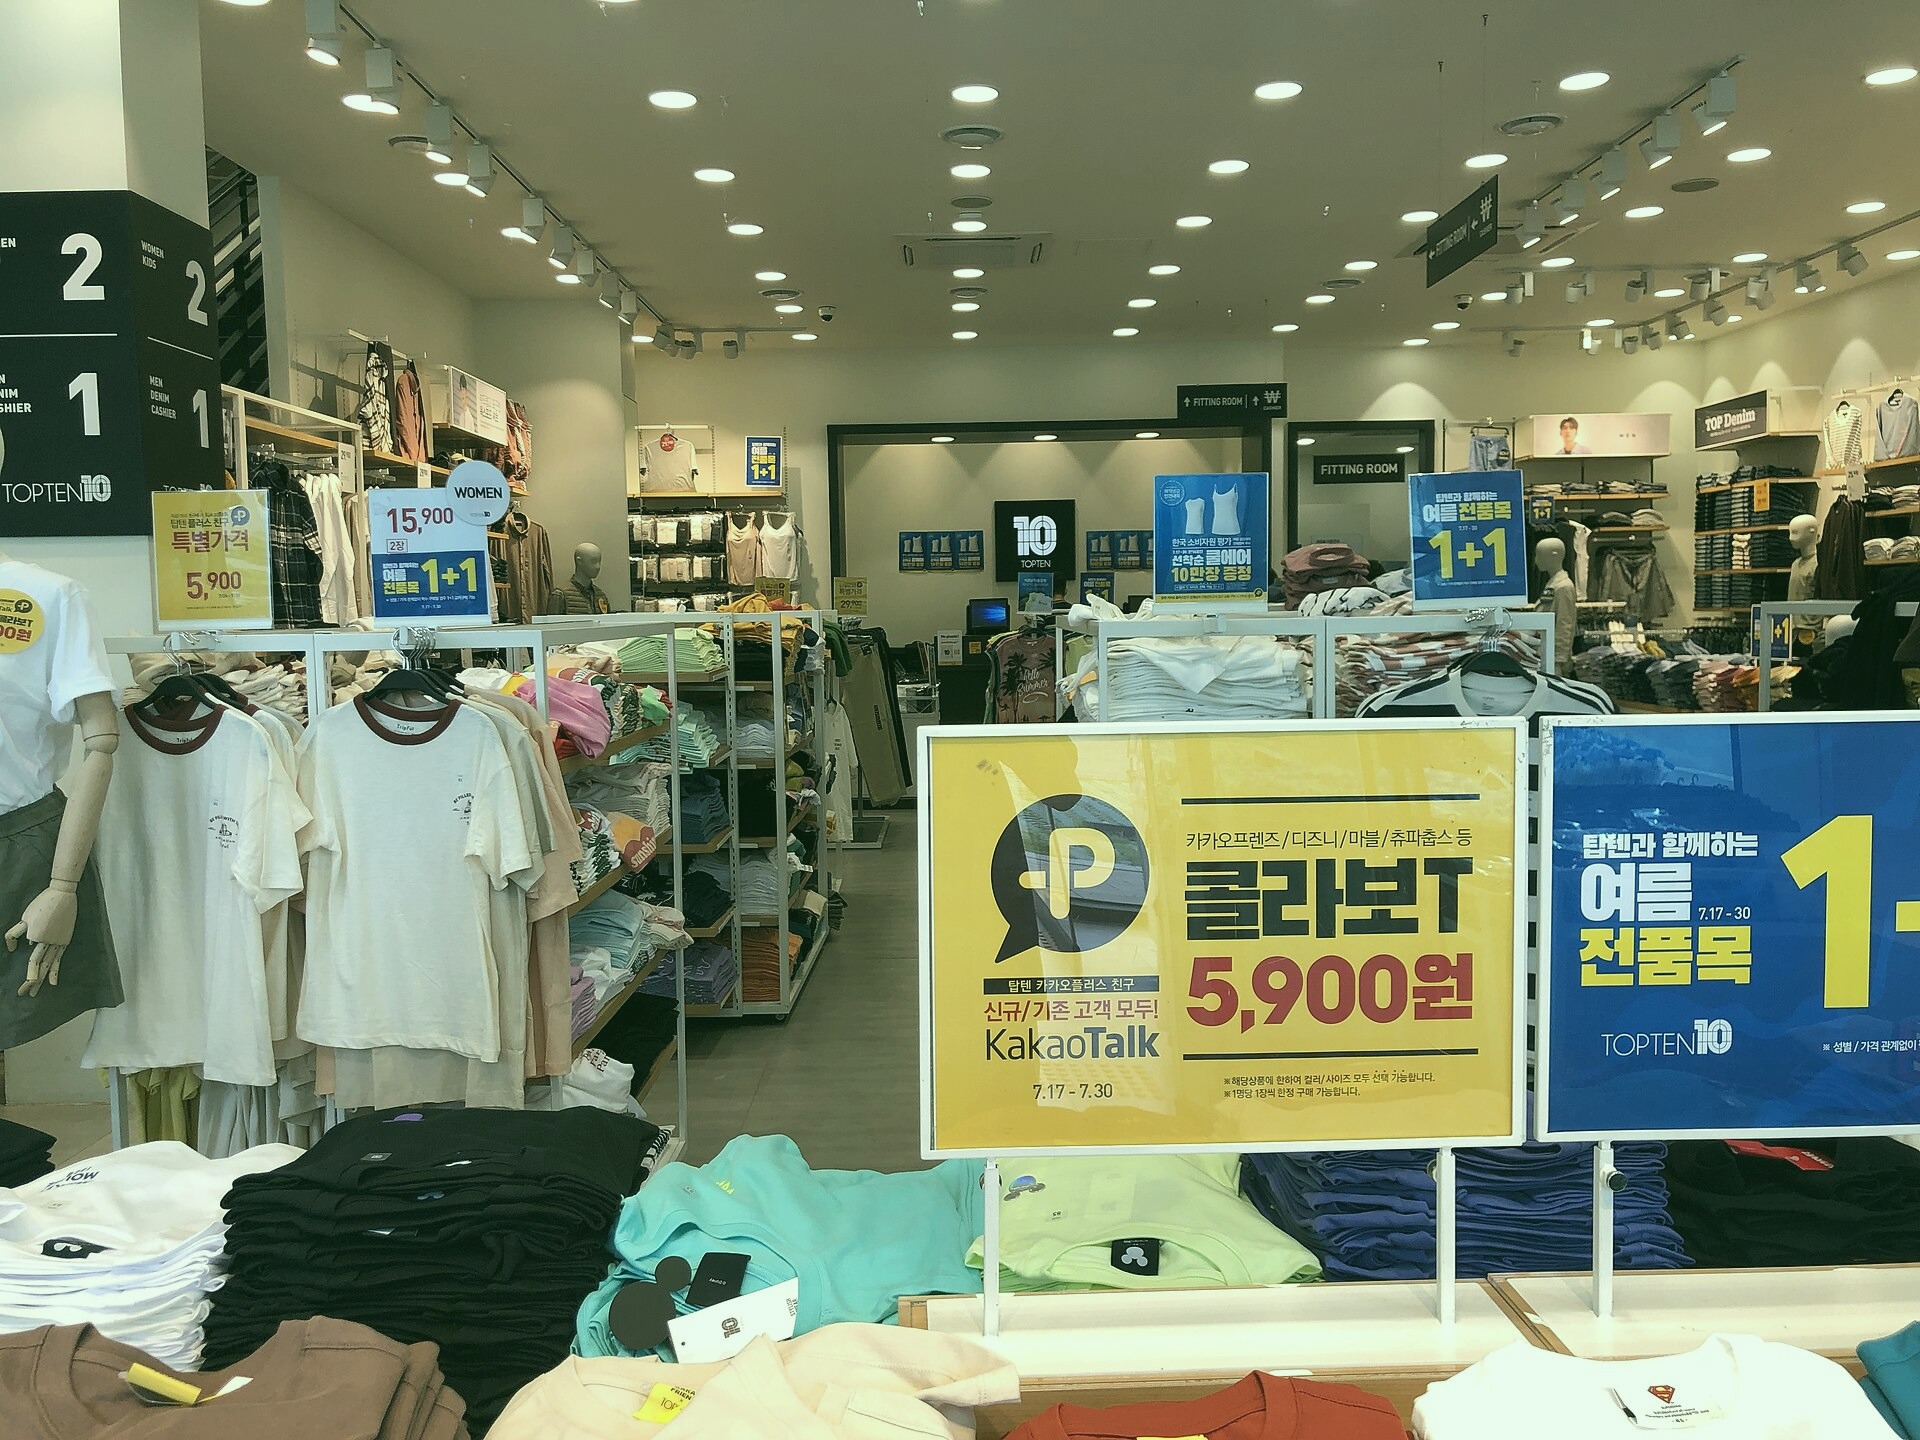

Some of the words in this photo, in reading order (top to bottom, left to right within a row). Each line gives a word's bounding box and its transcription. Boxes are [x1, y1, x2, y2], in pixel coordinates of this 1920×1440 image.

[141, 240, 164, 259] WOMEN
[61, 233, 105, 300] 2
[142, 255, 157, 269] KIDS
[186, 260, 208, 326] 2
[149, 375, 163, 388] MEN
[0, 388, 18, 398] NIM
[150, 389, 170, 403] DENIM
[1193, 397, 1221, 407] FITTING
[1222, 397, 1243, 406] ROOM
[0, 403, 32, 413] SHIER
[68, 372, 101, 436] 1
[151, 404, 176, 419] CASHIER
[193, 389, 209, 449] 1
[1705, 415, 1723, 432] TOP
[1724, 408, 1756, 428] Denim
[751, 464, 776, 480] 1+1
[1320, 464, 1364, 476] FITTING
[1366, 463, 1398, 475] ROOM
[454, 487, 503, 499] WOMEN
[387, 507, 454, 535] 15,900
[1423, 503, 1458, 522] 여름
[1459, 501, 1512, 521] 전품목
[1533, 508, 1551, 519] 1+1
[172, 529, 249, 553] 특별가격
[1013, 515, 1057, 556] 10
[390, 541, 405, 551] 2장
[1428, 527, 1507, 579] 1+1
[1020, 560, 1051, 568] TOPTEN
[421, 556, 478, 594] 1+1
[1171, 566, 1220, 583] 10만장
[1223, 566, 1252, 582] 증정
[187, 571, 242, 601] 5,900
[1456, 828, 1473, 847] 등
[1582, 832, 1656, 859] 탑텐과
[1662, 831, 1759, 858] 함께하는
[1184, 856, 1474, 941] 콜라보T
[1580, 862, 1692, 923] 여름
[1579, 925, 1752, 987] 전품목
[1008, 981, 1032, 993] 탑텐
[1035, 978, 1107, 993] 카카오플러스
[1111, 978, 1135, 991] 친구
[1186, 952, 1474, 1034] 5,900원
[1073, 999, 1112, 1020] 고객
[1115, 999, 1159, 1020] 모두!
[985, 1024, 1160, 1061] KakaoTalk
[1601, 1018, 1733, 1057] TOPTEN10
[1833, 1041, 1852, 1053] 성별
[1860, 1040, 1879, 1052] 가격
[1881, 1040, 1917, 1052] 관계없이
[1276, 1075, 1302, 1086] 한하여
[1353, 1073, 1370, 1083] 모두
[1372, 1072, 1389, 1083] 선택
[1391, 1072, 1436, 1083] 가능합니다.
[1255, 1088, 1275, 1098] 1장씩
[1277, 1087, 1295, 1098] 한정
[1296, 1087, 1314, 1097] 구매
[1316, 1086, 1361, 1097] 가능합니다.
[670, 1387, 693, 1401] FRIEN
